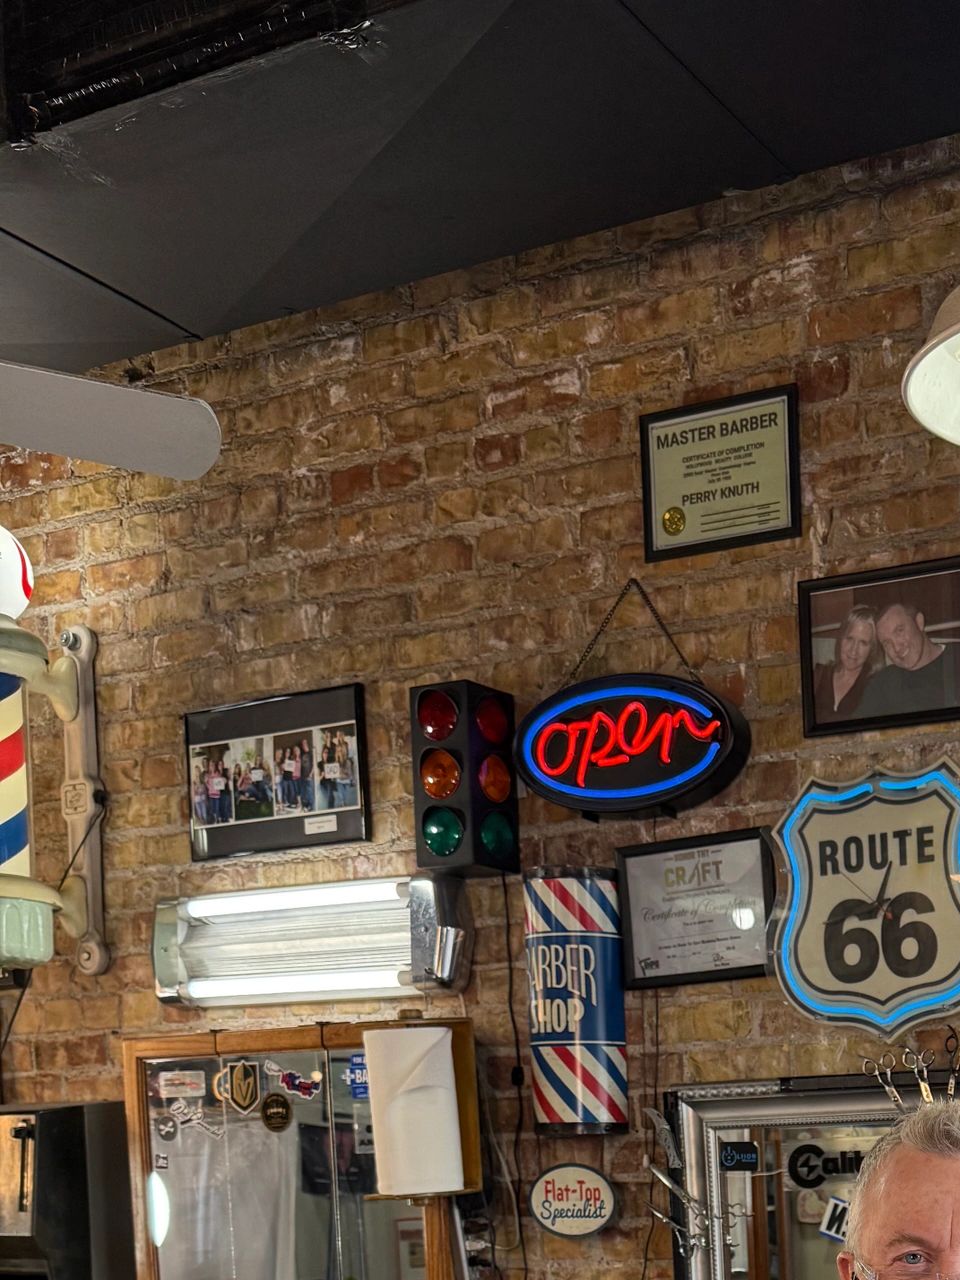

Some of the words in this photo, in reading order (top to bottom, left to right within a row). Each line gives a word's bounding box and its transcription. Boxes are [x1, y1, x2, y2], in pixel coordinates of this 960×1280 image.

[657, 424, 716, 450] MASTER
[720, 411, 779, 437] BARBER
[682, 450, 717, 463] CERTIFICATE
[725, 442, 765, 455] COMPLETION
[681, 489, 718, 506] PERRY
[720, 481, 760, 500] KNUTH
[819, 825, 935, 877] ROUTE
[664, 860, 723, 888] CRAFT
[824, 891, 938, 984] 66
[531, 998, 585, 1034] SHOP
[544, 1178, 601, 1209] Flat-Top
[540, 1199, 606, 1226] Specialist
